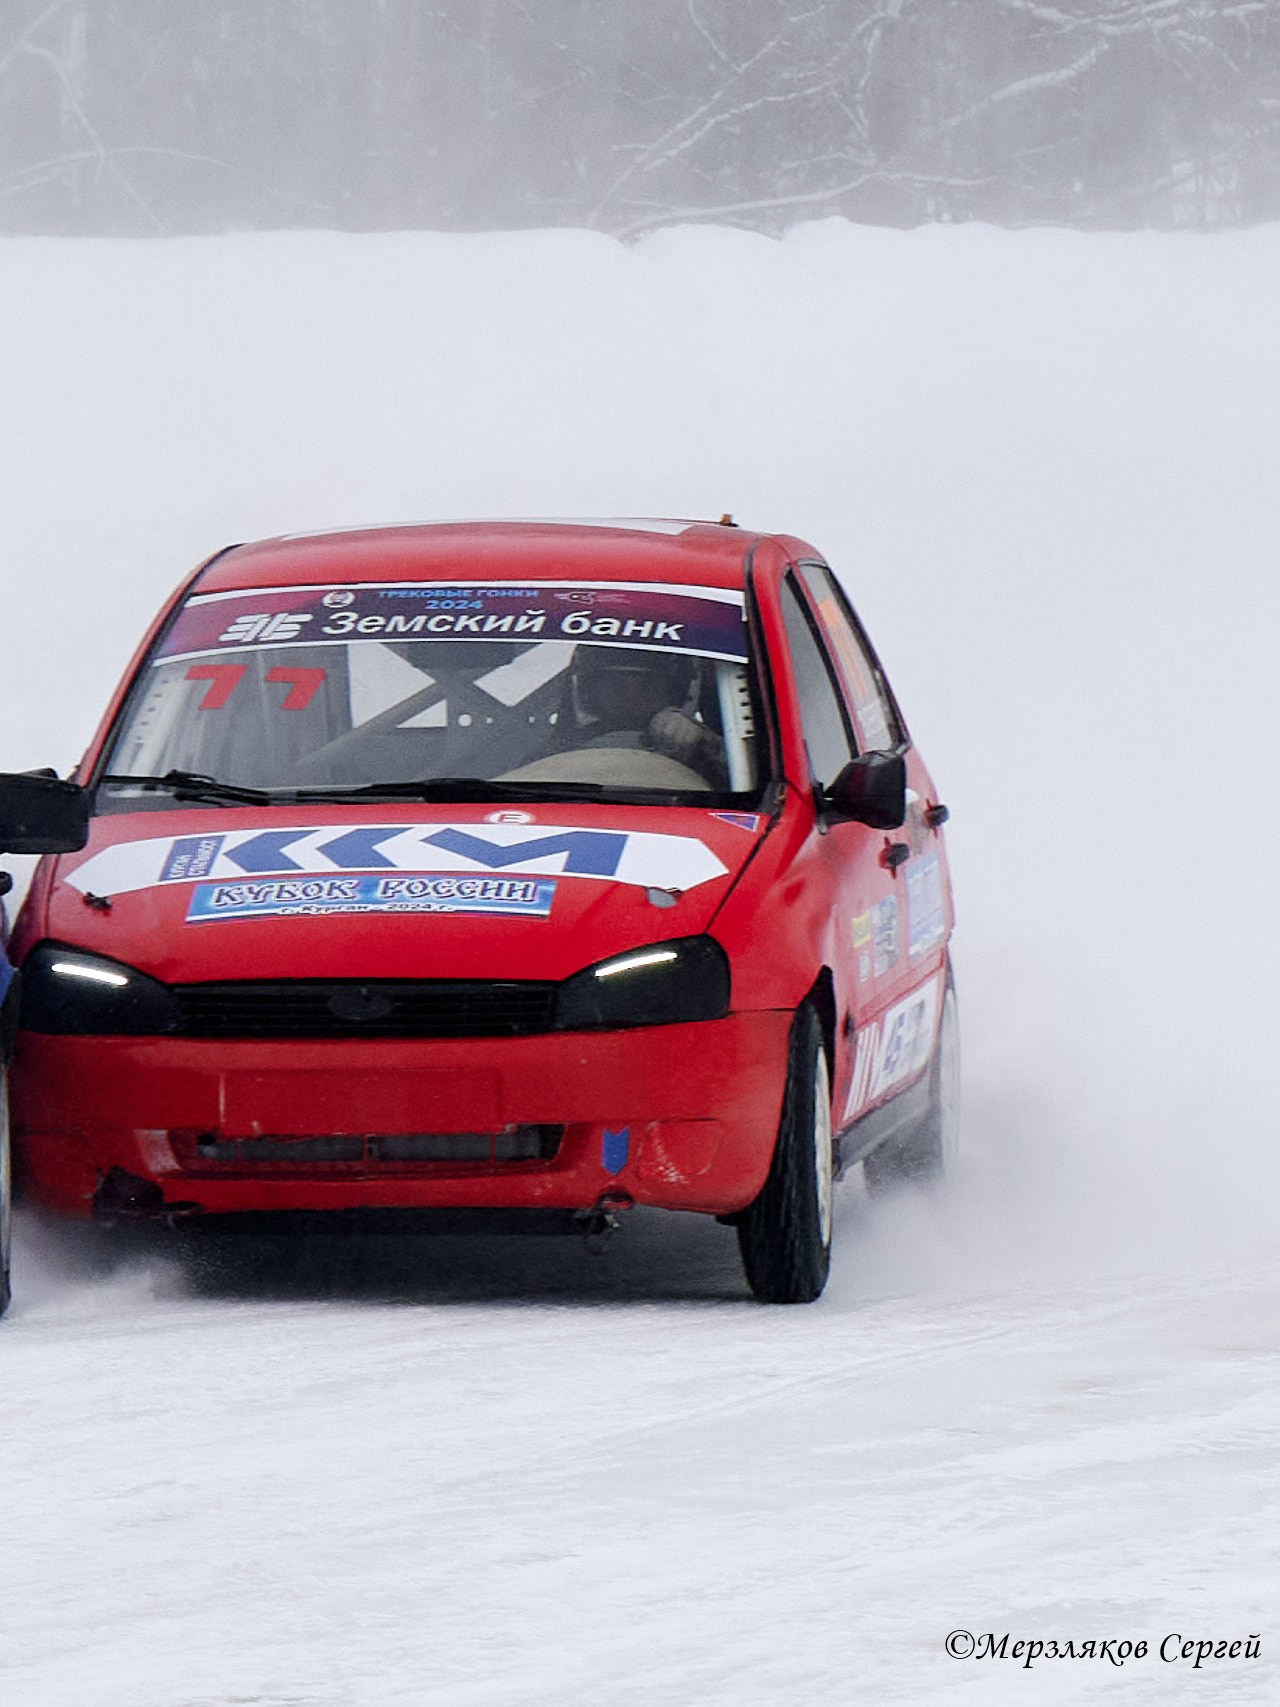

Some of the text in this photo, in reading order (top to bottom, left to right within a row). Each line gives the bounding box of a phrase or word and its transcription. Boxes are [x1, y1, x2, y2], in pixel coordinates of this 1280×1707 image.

[378, 588, 539, 598] ТРЕКОВЫЕ ГОНКИ
[424, 599, 484, 610] 2024
[321, 609, 685, 642] Земский банк
[184, 664, 327, 711] 77
[214, 877, 537, 907] КУБОК РОССИИ
[387, 902, 432, 911] 2024
